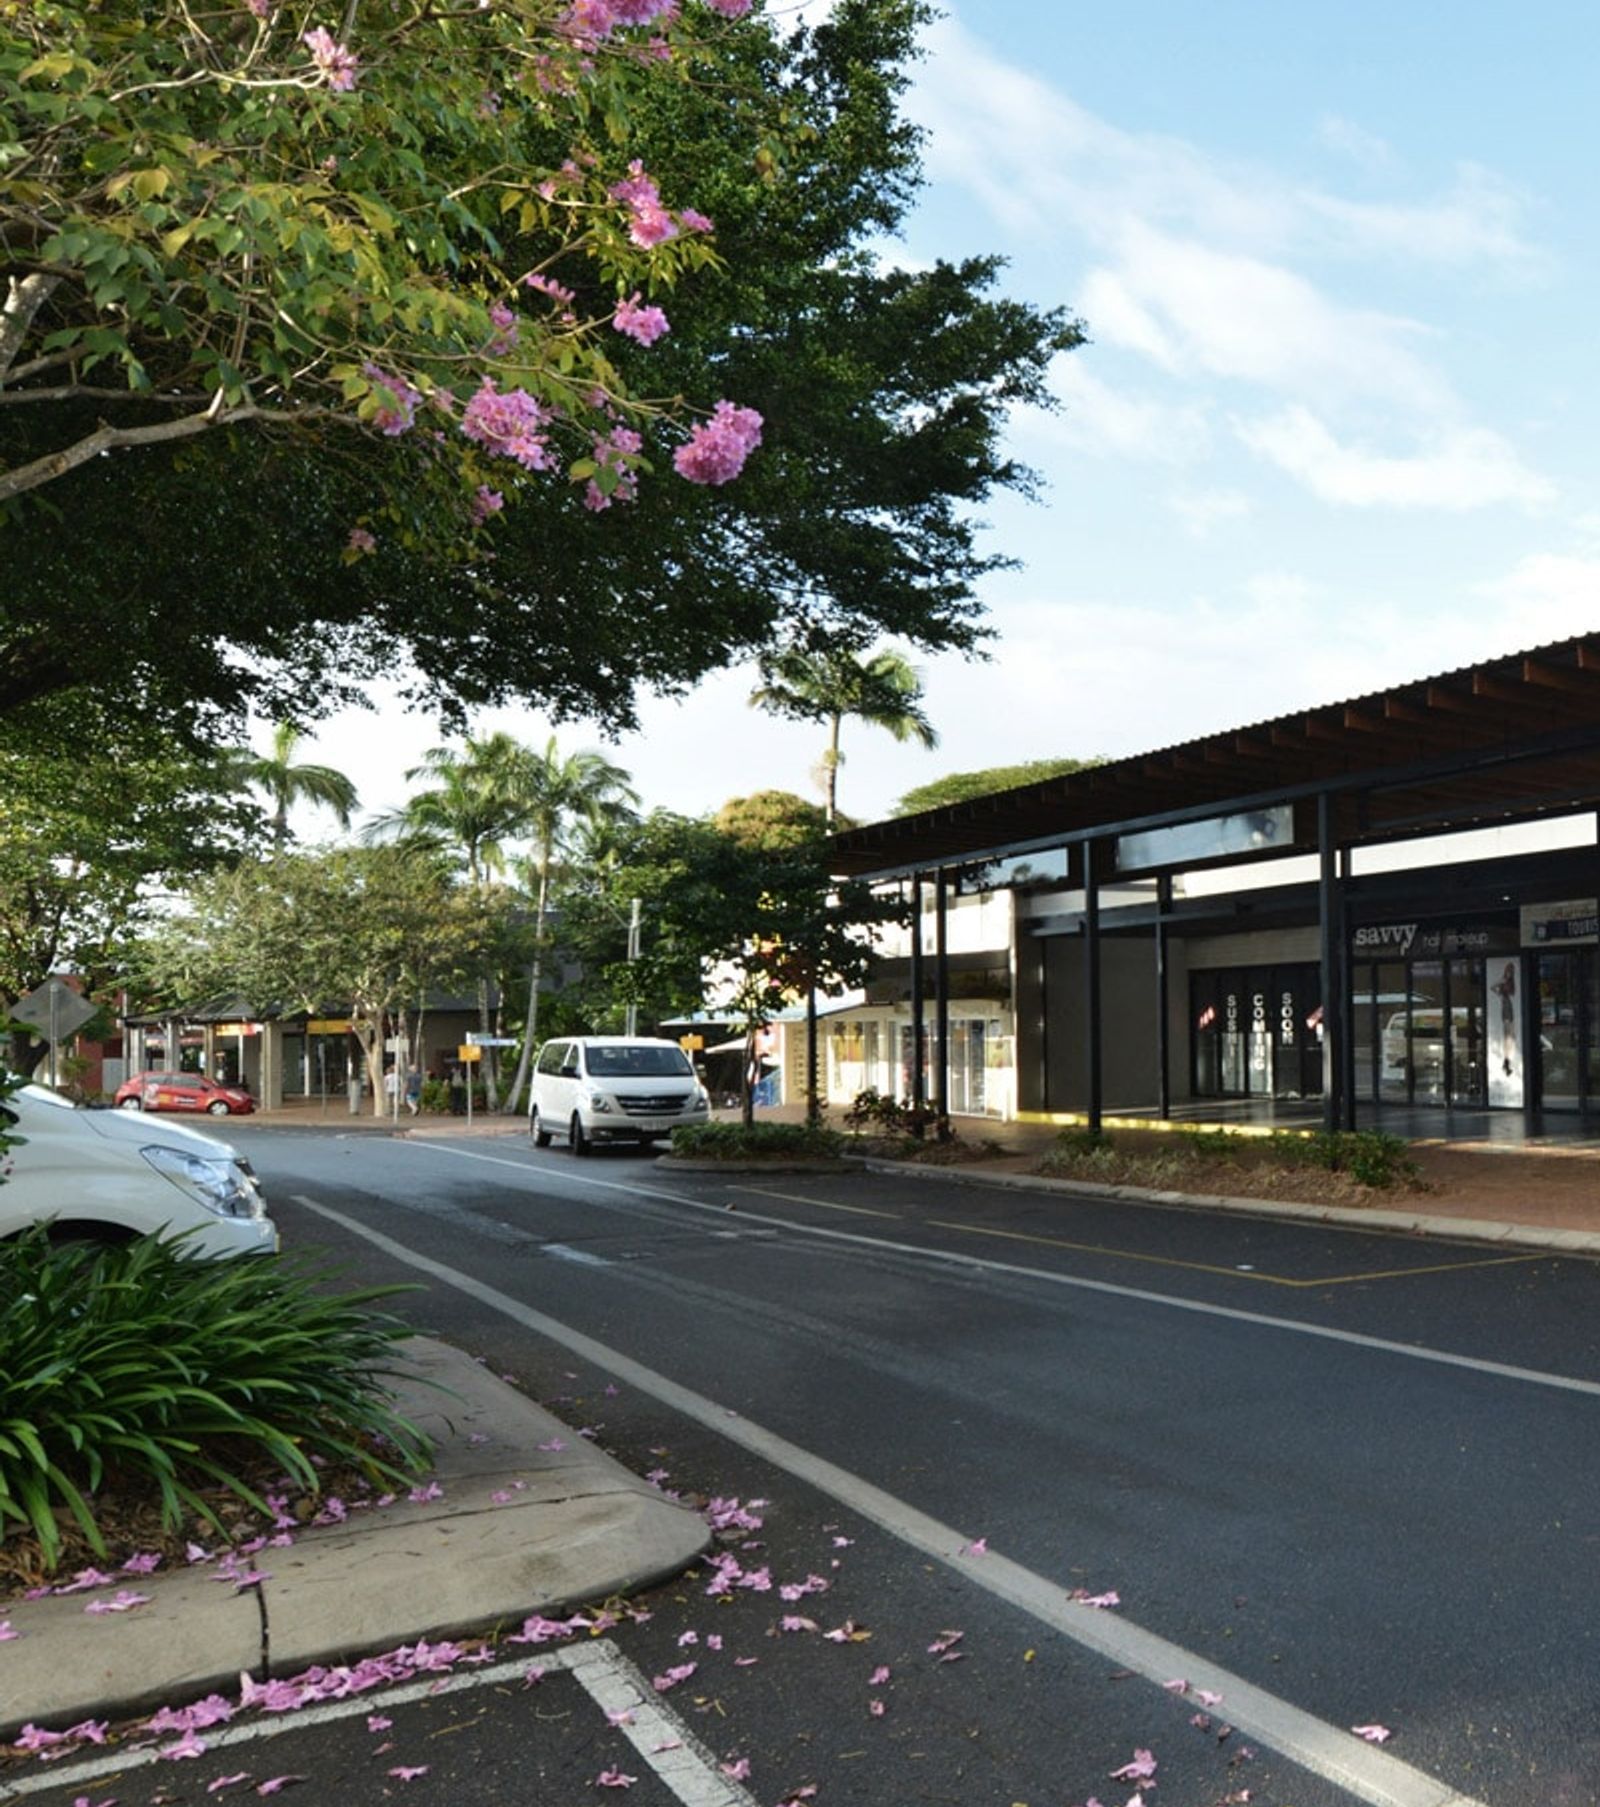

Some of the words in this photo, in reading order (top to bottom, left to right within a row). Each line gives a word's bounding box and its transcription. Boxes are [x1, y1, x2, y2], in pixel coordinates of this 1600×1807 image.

[1355, 924, 1417, 956] savvy
[1567, 918, 1600, 936] TOURIS
[1252, 994, 1265, 1071] COMING
[1281, 992, 1294, 1045] SOON
